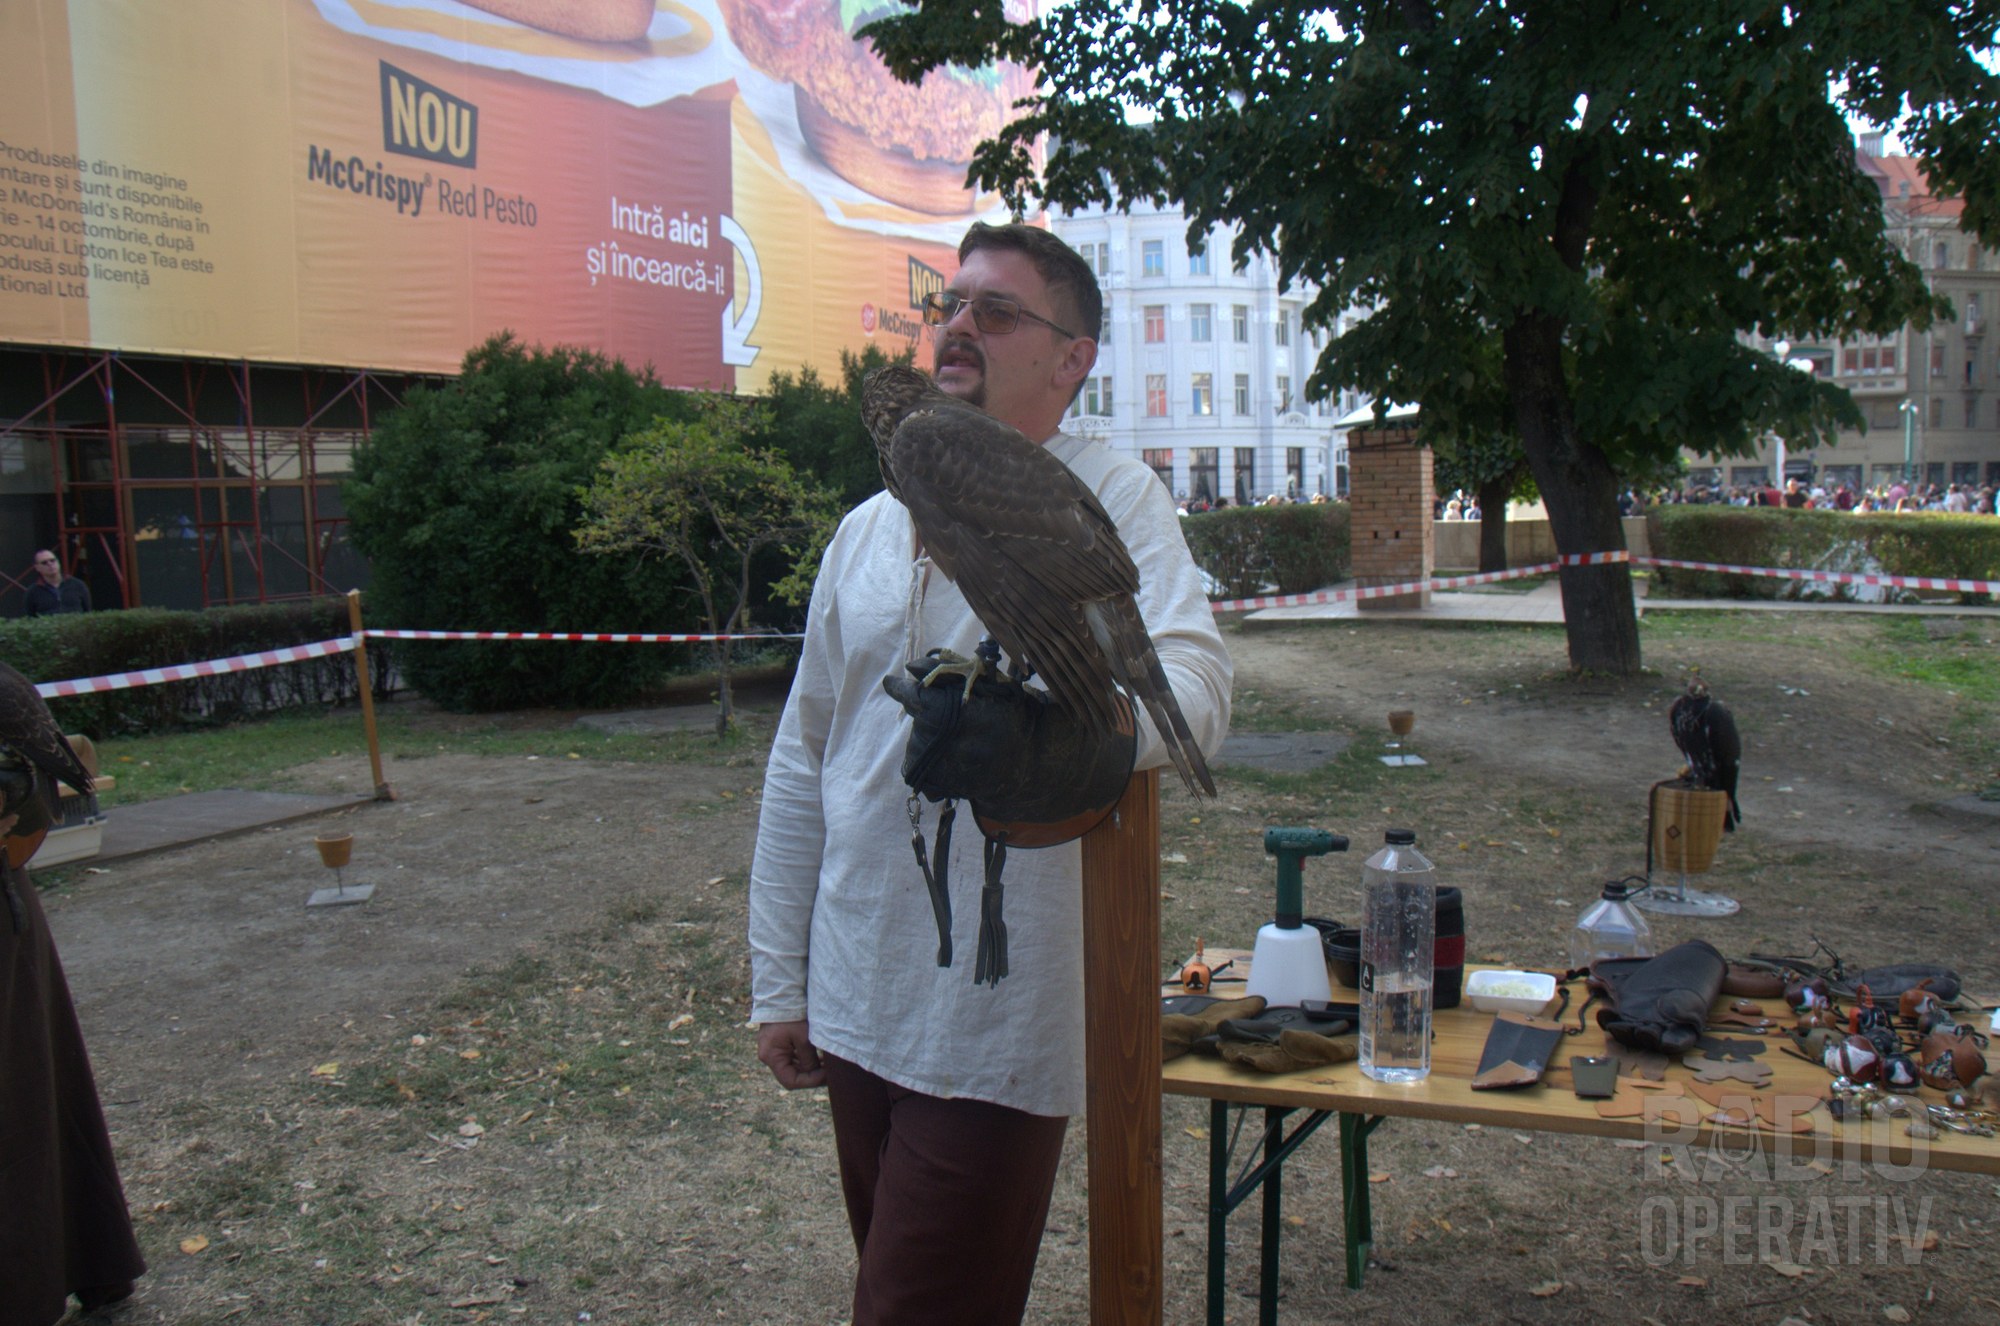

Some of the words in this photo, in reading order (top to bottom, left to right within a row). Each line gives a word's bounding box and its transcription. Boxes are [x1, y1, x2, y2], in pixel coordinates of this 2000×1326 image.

[389, 75, 471, 159] NOU
[55, 175, 69, 195] și
[73, 181, 113, 199] sunt
[116, 187, 203, 215] disponibile
[92, 159, 119, 178] din
[123, 165, 188, 192] imagine
[12, 189, 119, 220] McDonald's
[124, 206, 193, 232] România
[439, 178, 477, 218] Red
[483, 187, 538, 228] Pesto
[611, 196, 665, 239] Intră
[668, 211, 709, 249] aici
[37, 215, 56, 232] 14
[60, 220, 152, 247] octombrie,
[155, 232, 195, 254] după
[57, 259, 90, 278] sub
[93, 264, 150, 290] licență
[63, 239, 119, 262] Lipton
[122, 247, 147, 265] Ice
[151, 250, 178, 269] Tea
[181, 257, 214, 274] este
[586, 242, 607, 286] și
[610, 241, 725, 296] încearcă-i!
[57, 281, 90, 300] Ltd.
